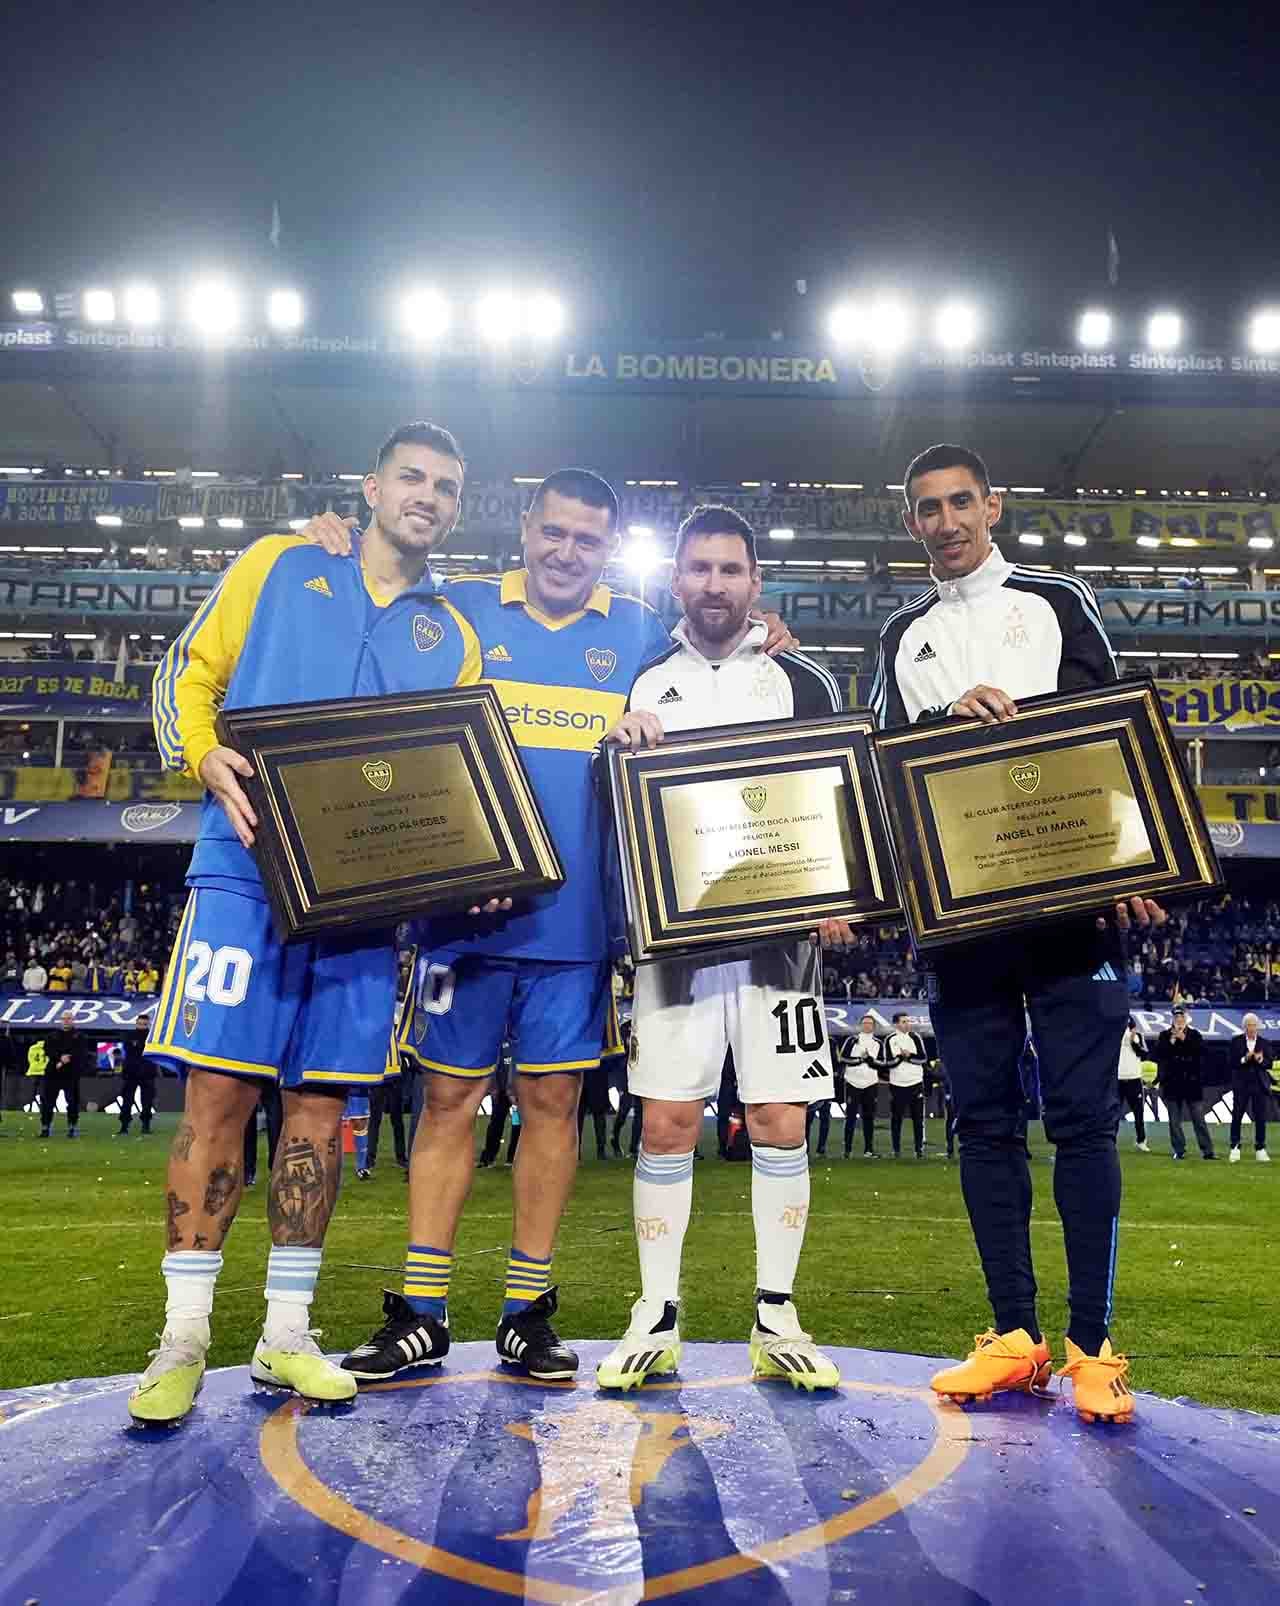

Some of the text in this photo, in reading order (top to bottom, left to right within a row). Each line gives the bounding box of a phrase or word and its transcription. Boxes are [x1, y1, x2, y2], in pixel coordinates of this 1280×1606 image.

[566, 354, 838, 384] LA BOMBONERA
[914, 651, 937, 663] adidas
[503, 703, 606, 732] etsson
[767, 815, 790, 826] BOCA
[976, 805, 1000, 817] CLUB
[1001, 799, 1041, 812] ATLETICO
[995, 829, 1034, 843] ANGEL
[1050, 818, 1088, 833] MARIA
[728, 841, 800, 859] LIONEL MESSI
[184, 939, 254, 1008] 20
[771, 997, 825, 1054] 10
